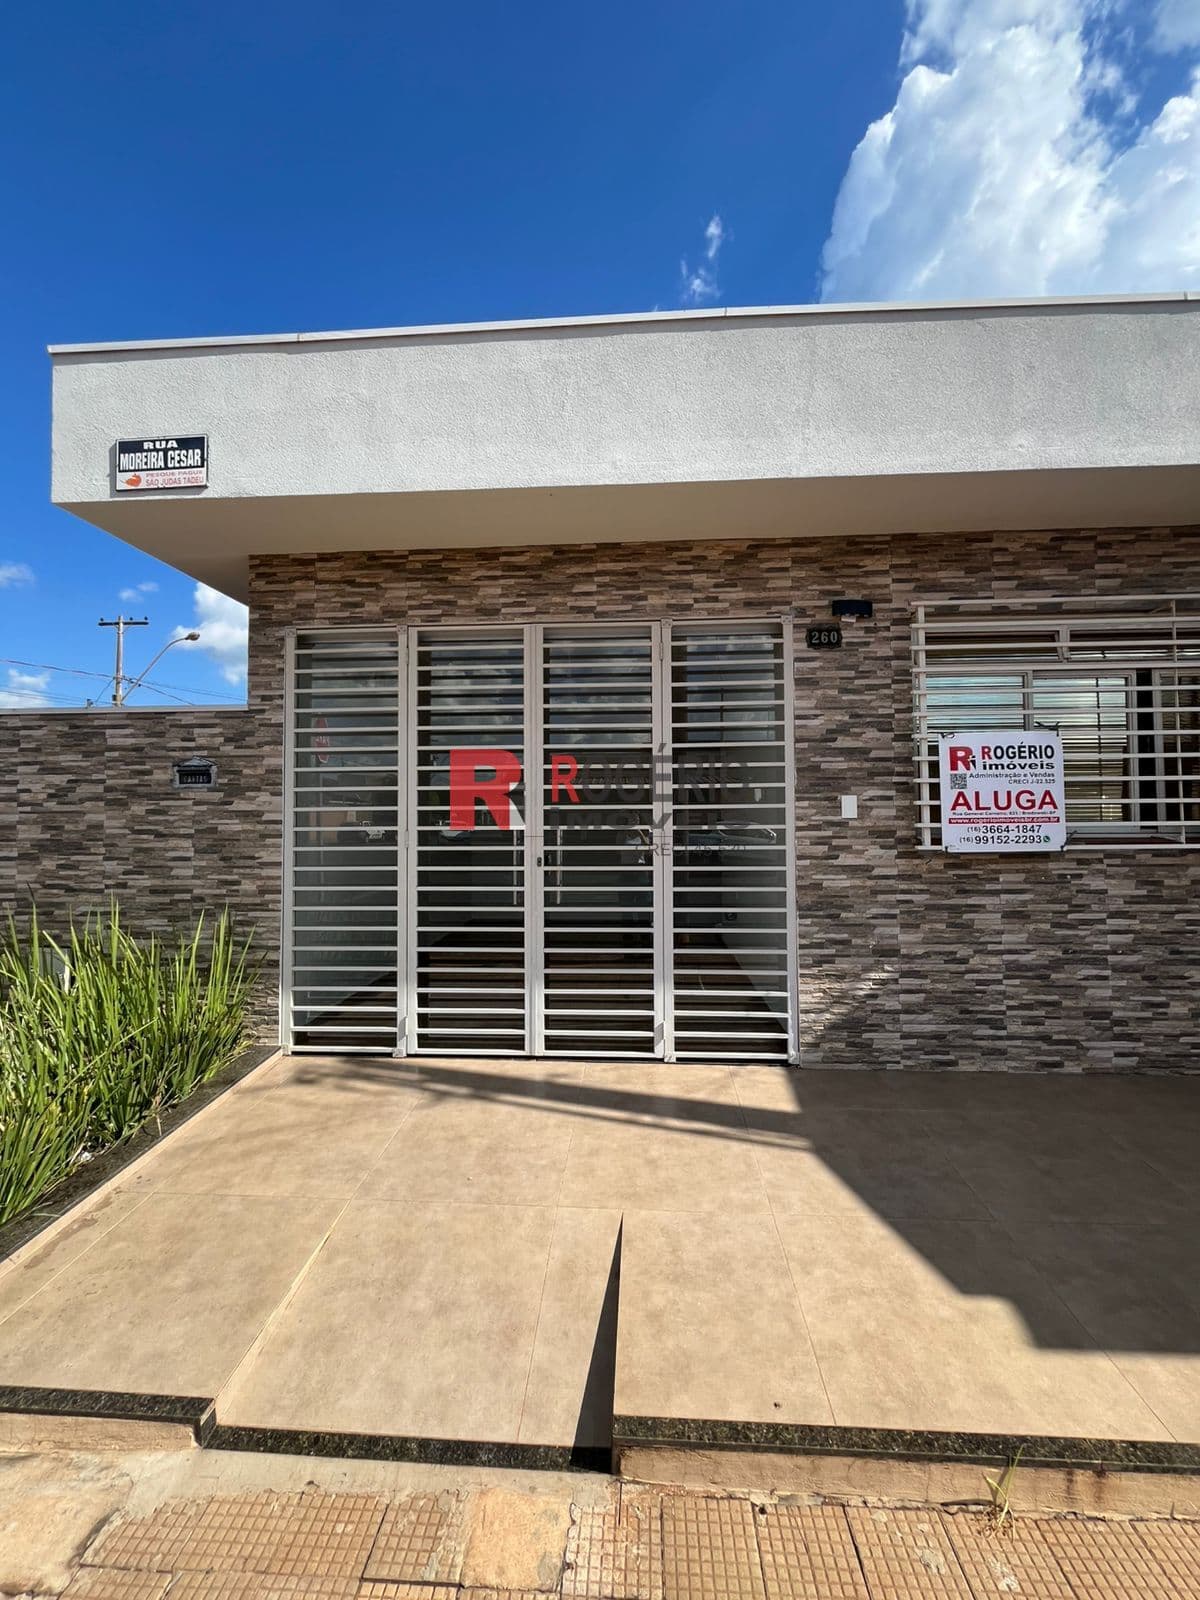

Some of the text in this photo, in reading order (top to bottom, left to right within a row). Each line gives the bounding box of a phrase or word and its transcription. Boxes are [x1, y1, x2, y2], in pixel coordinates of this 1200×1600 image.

[143, 440, 178, 450] RUA
[120, 449, 201, 471] MOREIRA CESAR
[811, 631, 838, 643] 260
[981, 741, 1055, 760] ROGÉRIO
[982, 760, 1055, 770] imóveis
[950, 790, 1058, 811] ALUGA
[982, 824, 1042, 834] 3664-1847
[959, 835, 1042, 845] (16) 99152-2293
